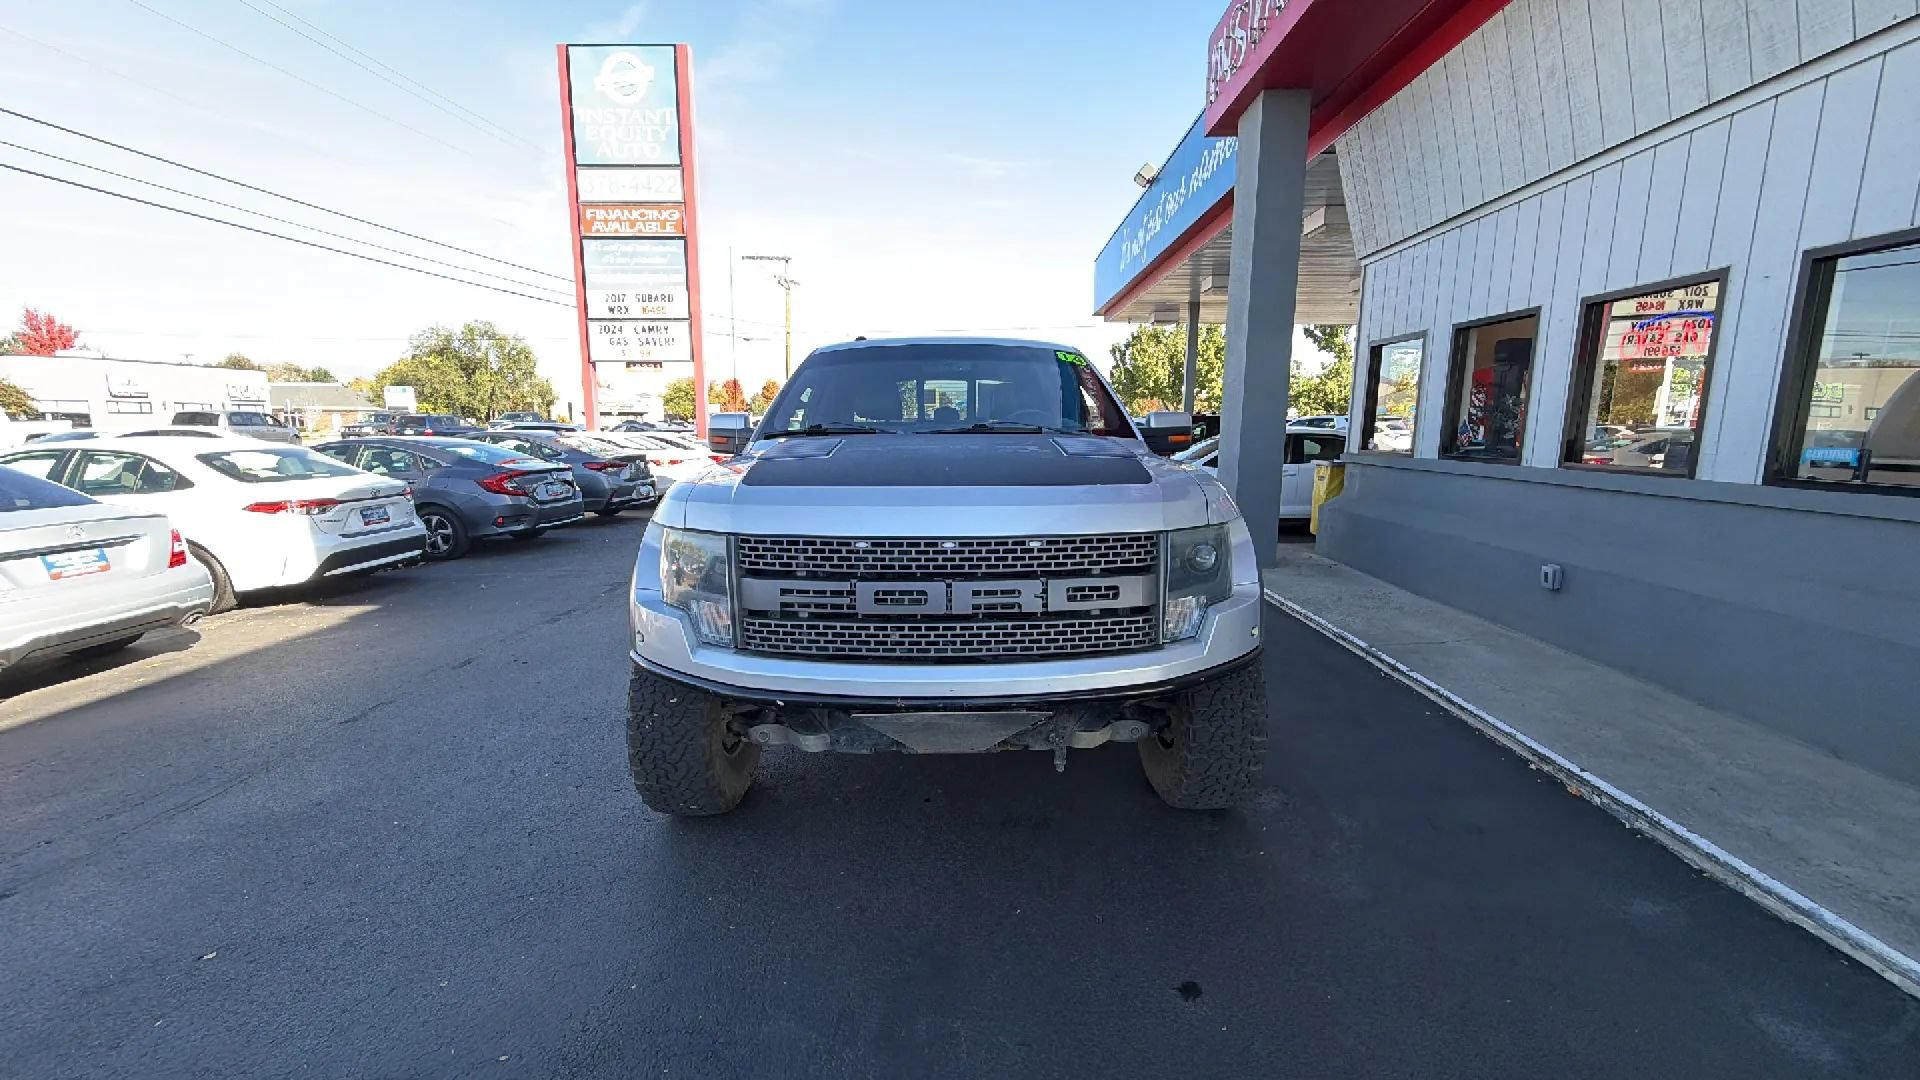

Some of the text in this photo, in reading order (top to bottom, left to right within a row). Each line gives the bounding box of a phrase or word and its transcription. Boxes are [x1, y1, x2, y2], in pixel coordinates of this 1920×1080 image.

[576, 108, 675, 125] INSTANT
[585, 125, 671, 142] EQUITY
[596, 142, 661, 158] AUTO
[586, 208, 681, 221] FINANCING
[591, 221, 677, 233] AVAILABLE
[605, 293, 674, 303] 2017 SUBARU
[608, 305, 630, 315] WRX
[598, 324, 669, 335] 2024 CAMRY
[609, 337, 675, 347] GAS SAVER!
[741, 578, 1157, 615] FORD
